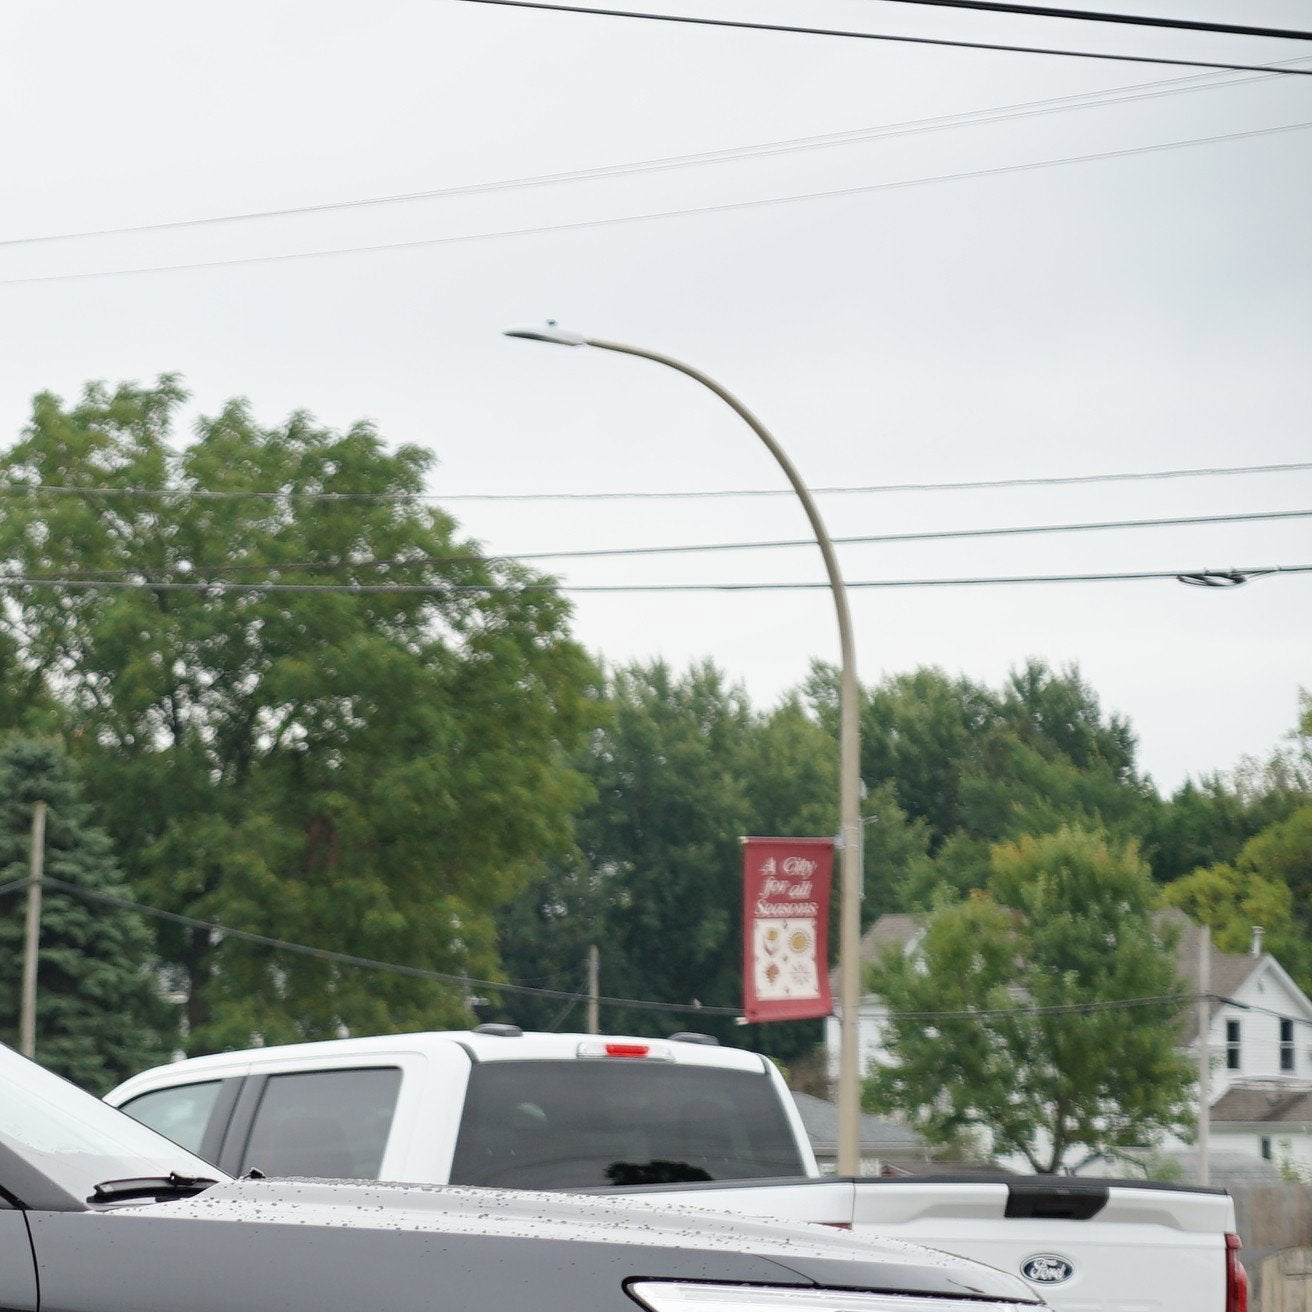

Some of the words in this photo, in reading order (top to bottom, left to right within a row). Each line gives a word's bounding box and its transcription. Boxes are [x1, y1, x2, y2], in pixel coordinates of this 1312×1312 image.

[759, 857, 777, 874] A
[782, 856, 818, 877] City
[759, 876, 788, 899] for
[788, 880, 814, 899] all
[754, 899, 819, 918] Seasons
[1028, 1256, 1068, 1282] Ford
